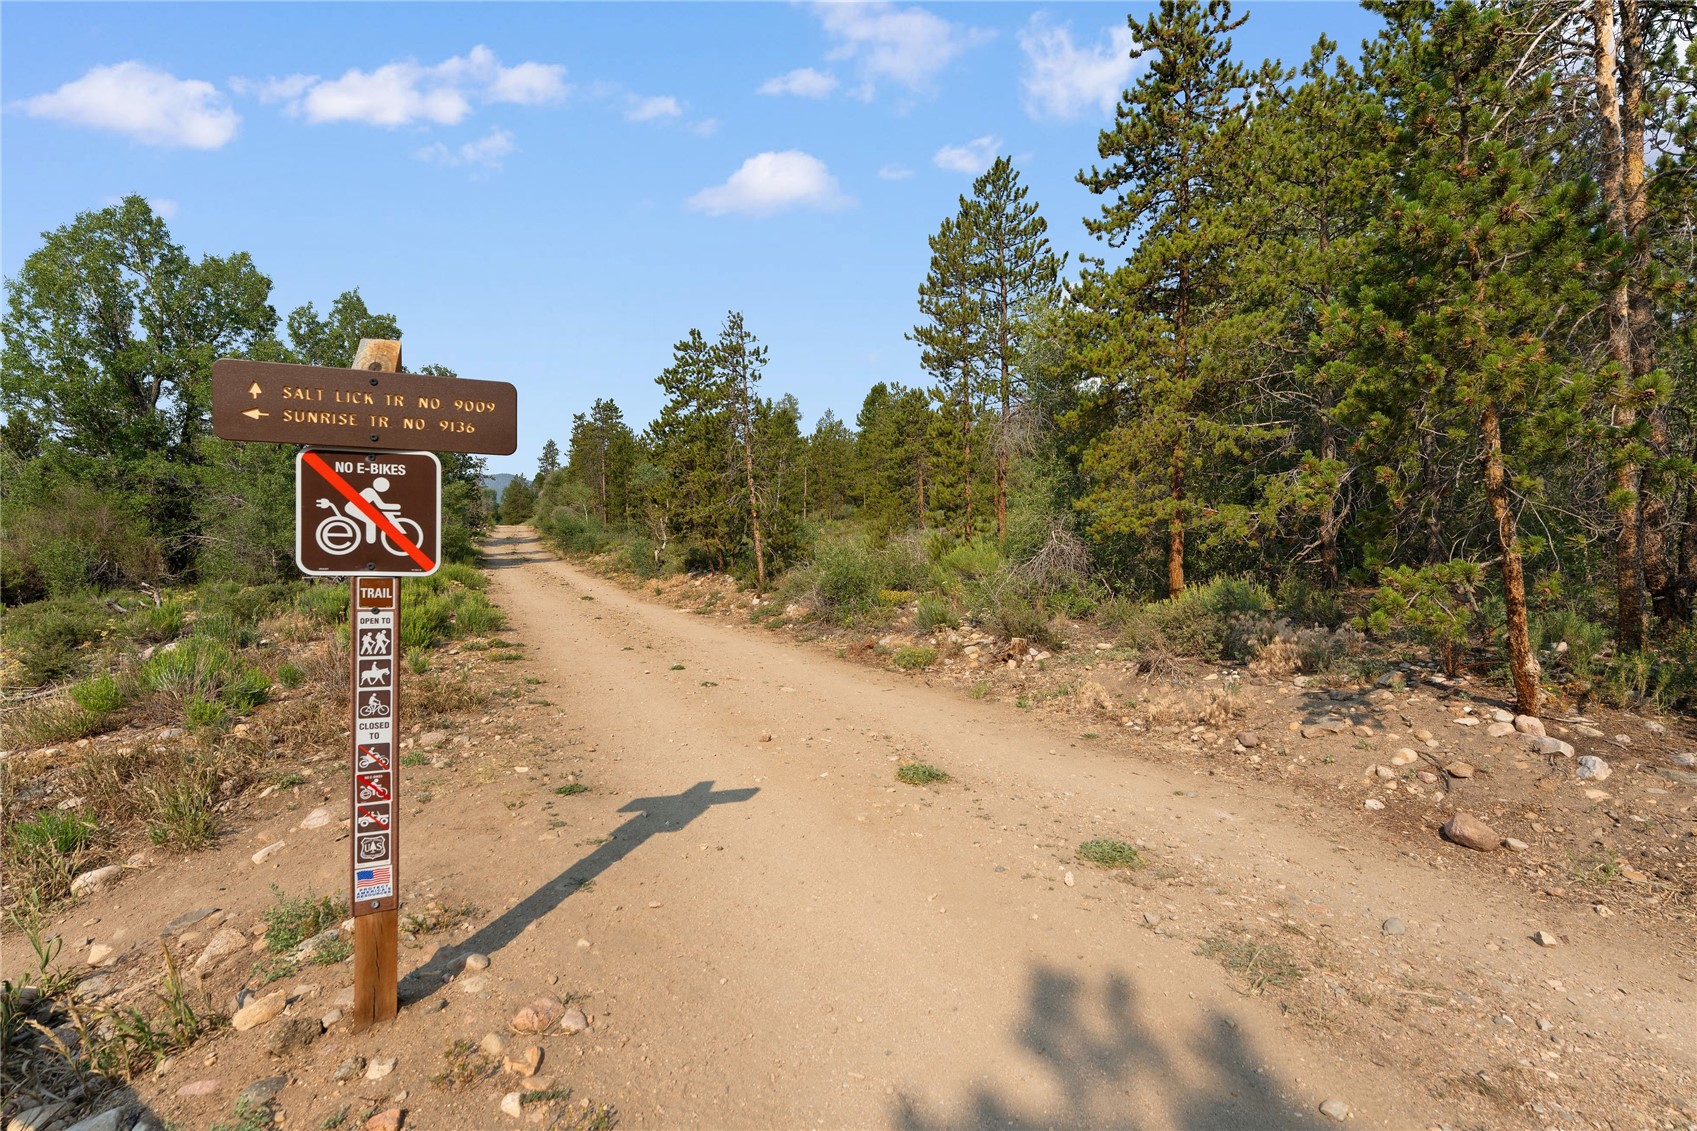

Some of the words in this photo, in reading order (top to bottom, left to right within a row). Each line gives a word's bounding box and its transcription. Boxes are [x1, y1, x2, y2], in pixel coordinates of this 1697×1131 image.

[282, 386, 324, 401] SALT
[335, 390, 374, 405] LICK
[454, 399, 496, 413] 9009
[283, 409, 358, 426] SUNRISE
[440, 420, 475, 433] 9136
[335, 461, 353, 473] NO
[357, 463, 406, 476] E-BIKES
[360, 587, 392, 599] TRAIL
[360, 617, 379, 625] OPEN
[359, 722, 390, 730] CLOSED
[369, 732, 380, 740] TO
